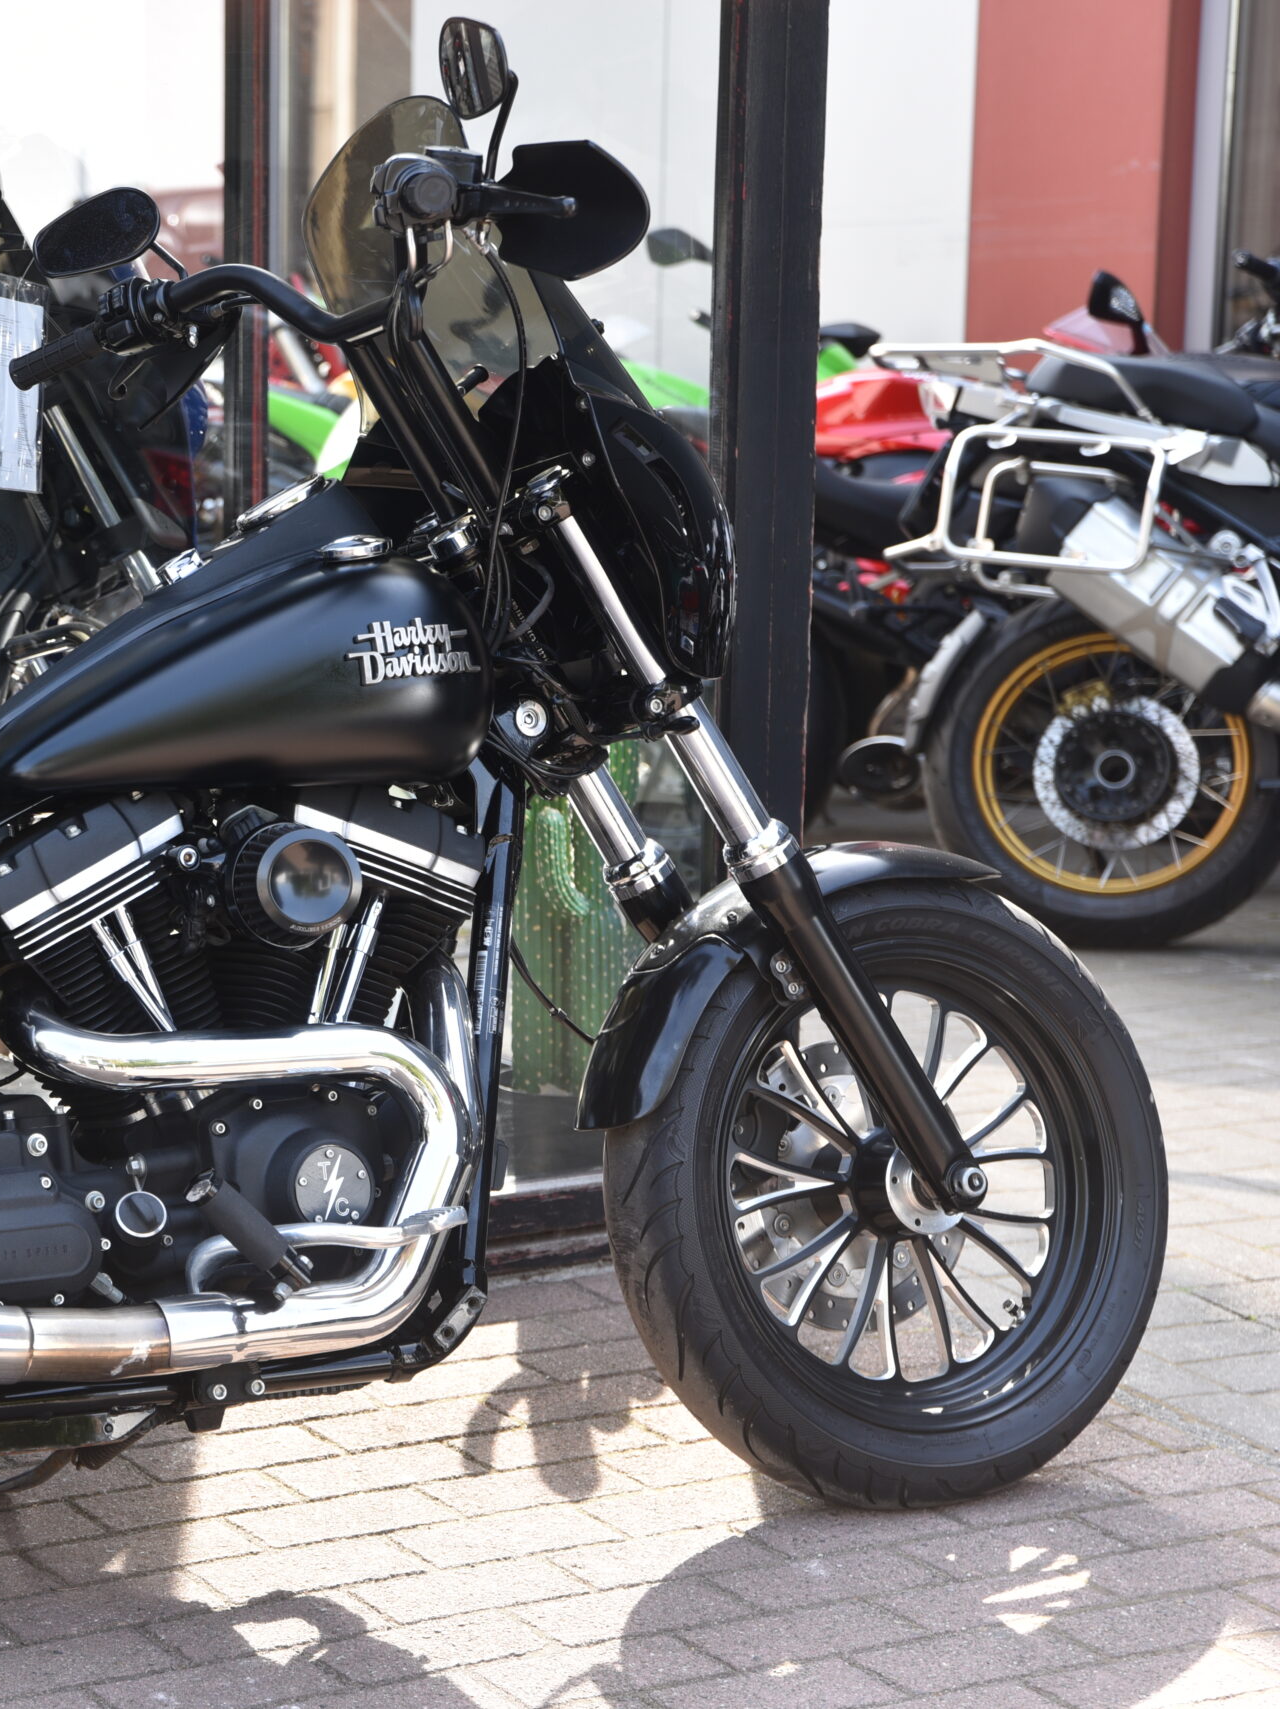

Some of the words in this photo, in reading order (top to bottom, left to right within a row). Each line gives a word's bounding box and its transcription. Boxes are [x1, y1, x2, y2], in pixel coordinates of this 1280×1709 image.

[354, 617, 467, 654] Harley
[345, 644, 480, 686] Davidson
[874, 917, 960, 935] COBRA
[317, 1161, 331, 1180] T
[335, 1197, 350, 1216] C
